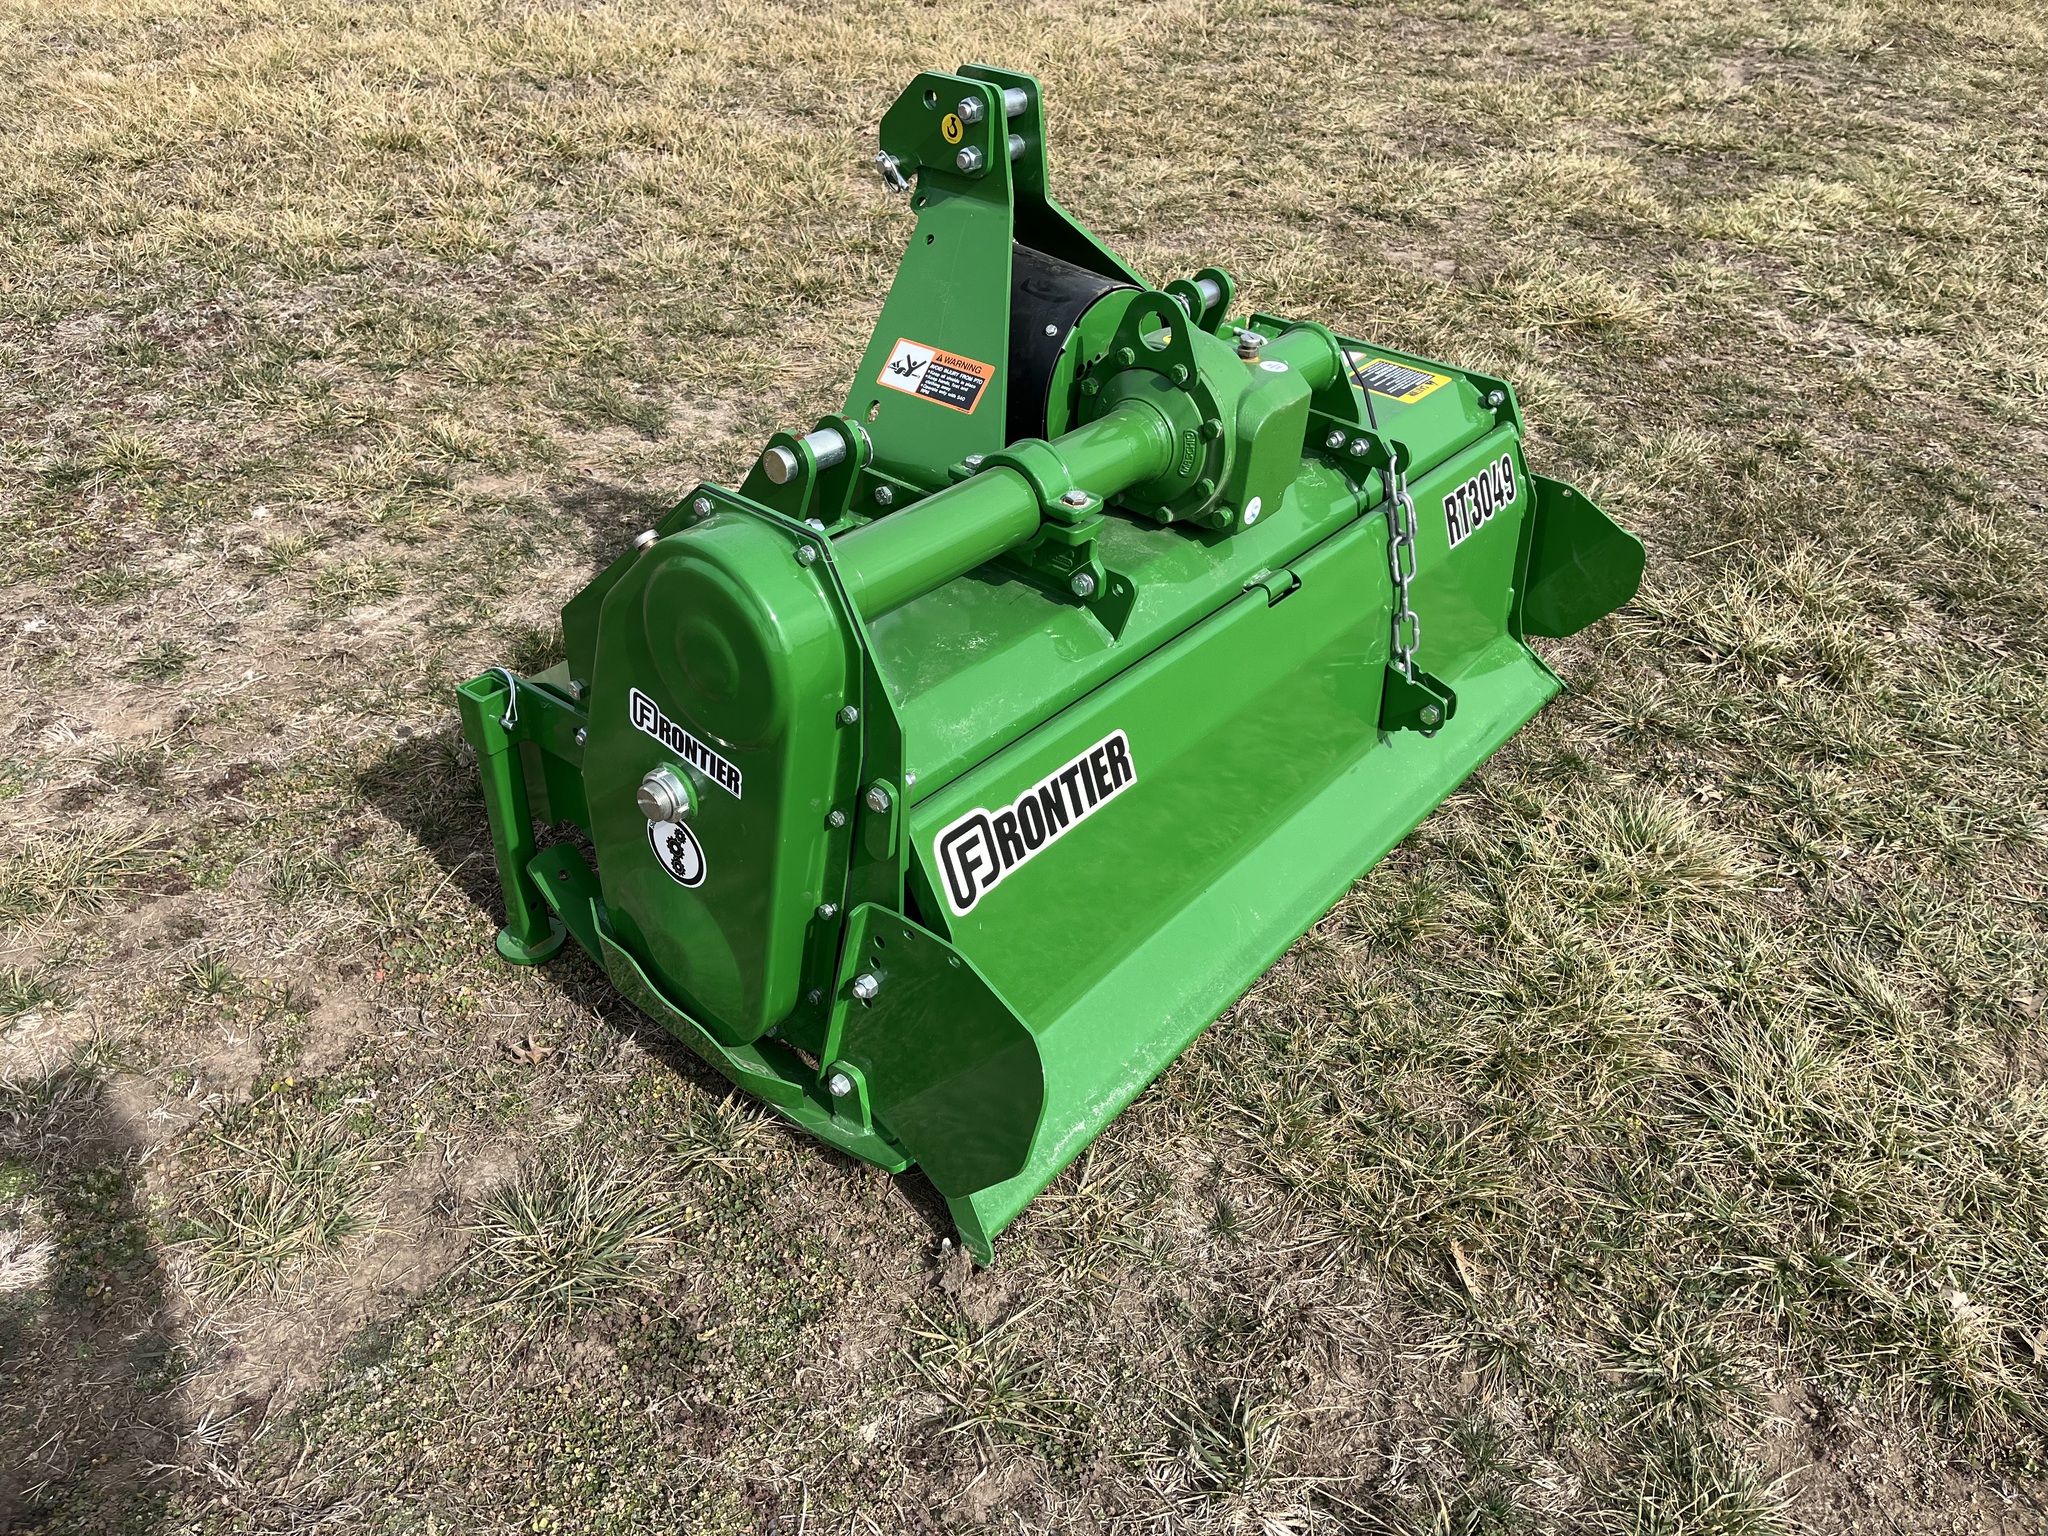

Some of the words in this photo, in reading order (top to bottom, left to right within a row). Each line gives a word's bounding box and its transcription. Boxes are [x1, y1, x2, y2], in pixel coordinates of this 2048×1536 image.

[944, 356, 982, 374] WARNING
[1444, 455, 1515, 546] RT3049
[633, 691, 742, 795] FRONTIER
[940, 735, 1133, 909] FRONTIER
